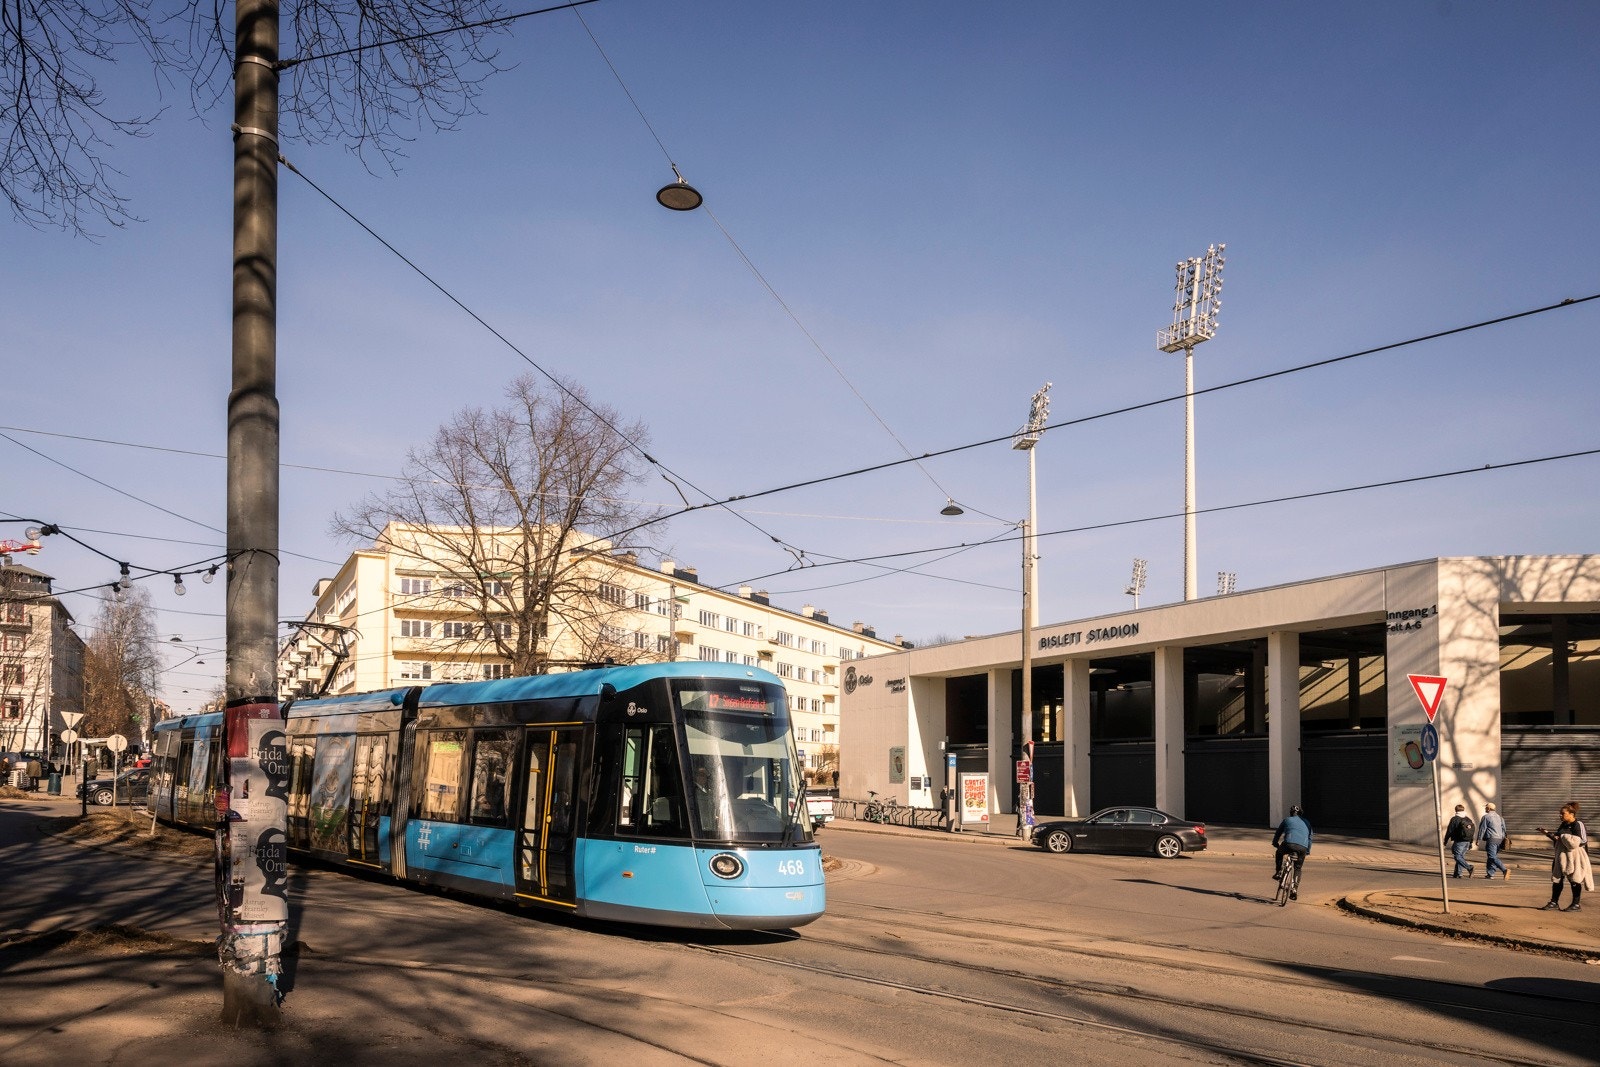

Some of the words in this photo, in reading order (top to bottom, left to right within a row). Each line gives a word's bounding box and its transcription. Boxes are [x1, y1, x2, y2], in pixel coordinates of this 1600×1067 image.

[1386, 608, 1428, 620] Inngang
[1431, 604, 1438, 614] 1
[1405, 621, 1422, 631] A-G
[1041, 631, 1082, 648] BISLETT
[1089, 622, 1139, 641] STADION
[708, 693, 719, 708] 17
[251, 747, 282, 760] Frida
[248, 844, 280, 858] Frida
[778, 860, 804, 876] 468
